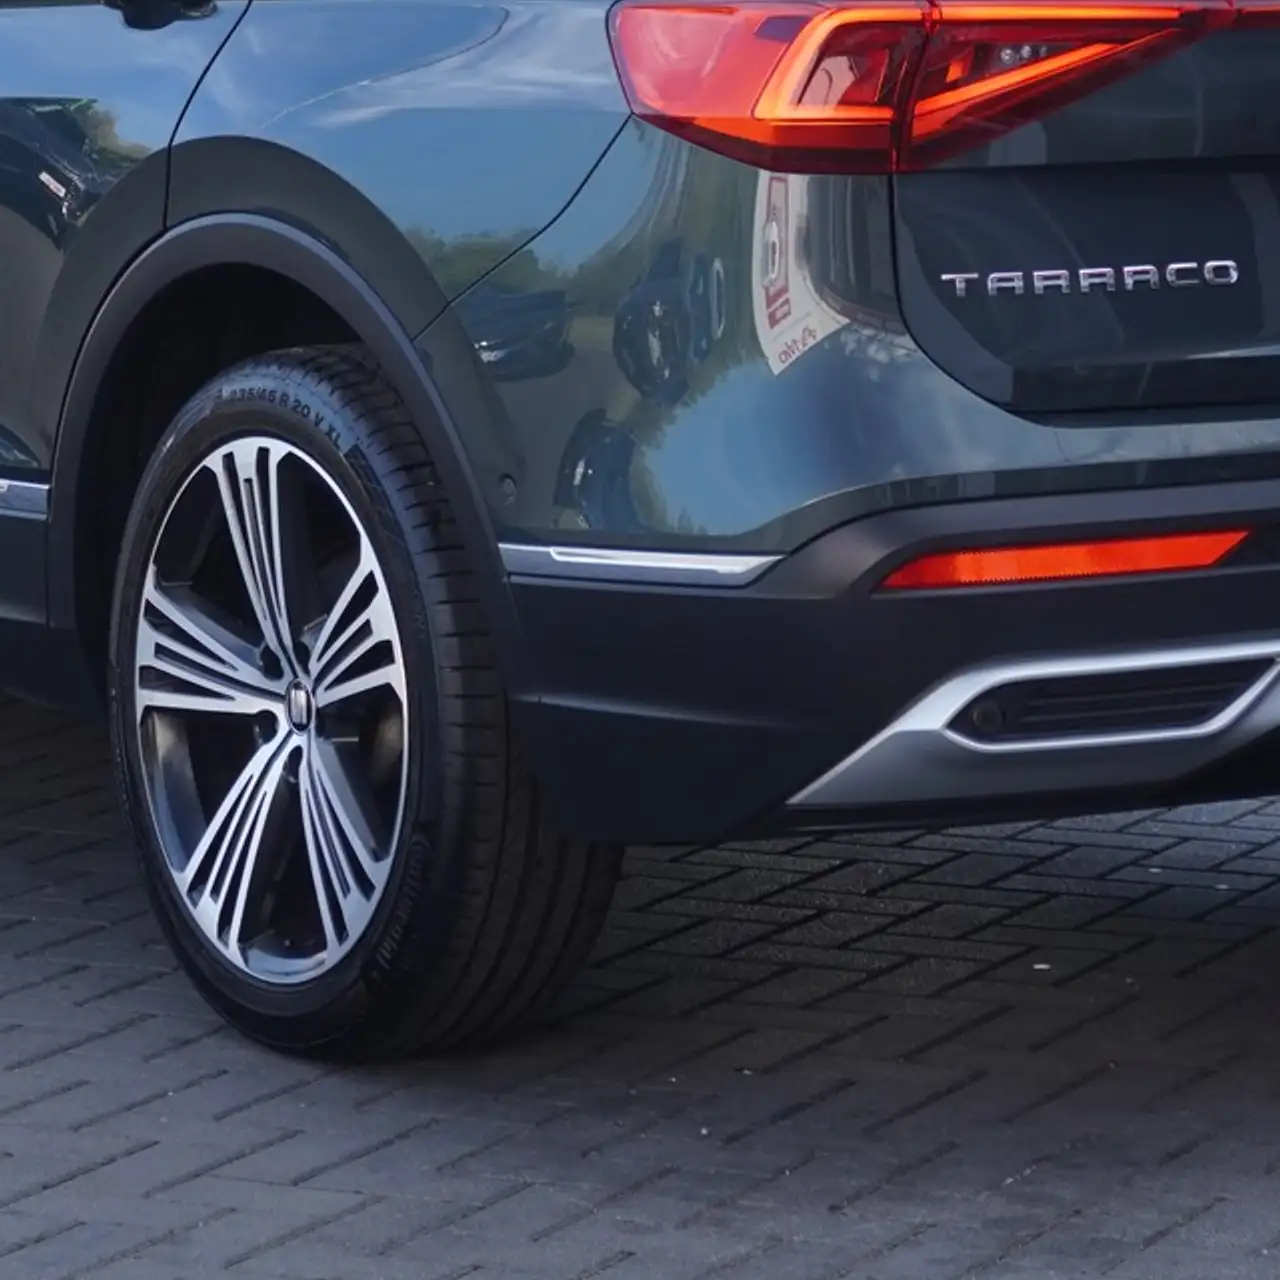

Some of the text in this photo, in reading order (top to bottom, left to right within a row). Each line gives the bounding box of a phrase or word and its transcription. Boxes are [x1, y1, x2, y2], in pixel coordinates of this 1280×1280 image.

[940, 259, 1240, 297] TARRACO
[278, 391, 290, 408] R
[291, 399, 311, 418] 20
